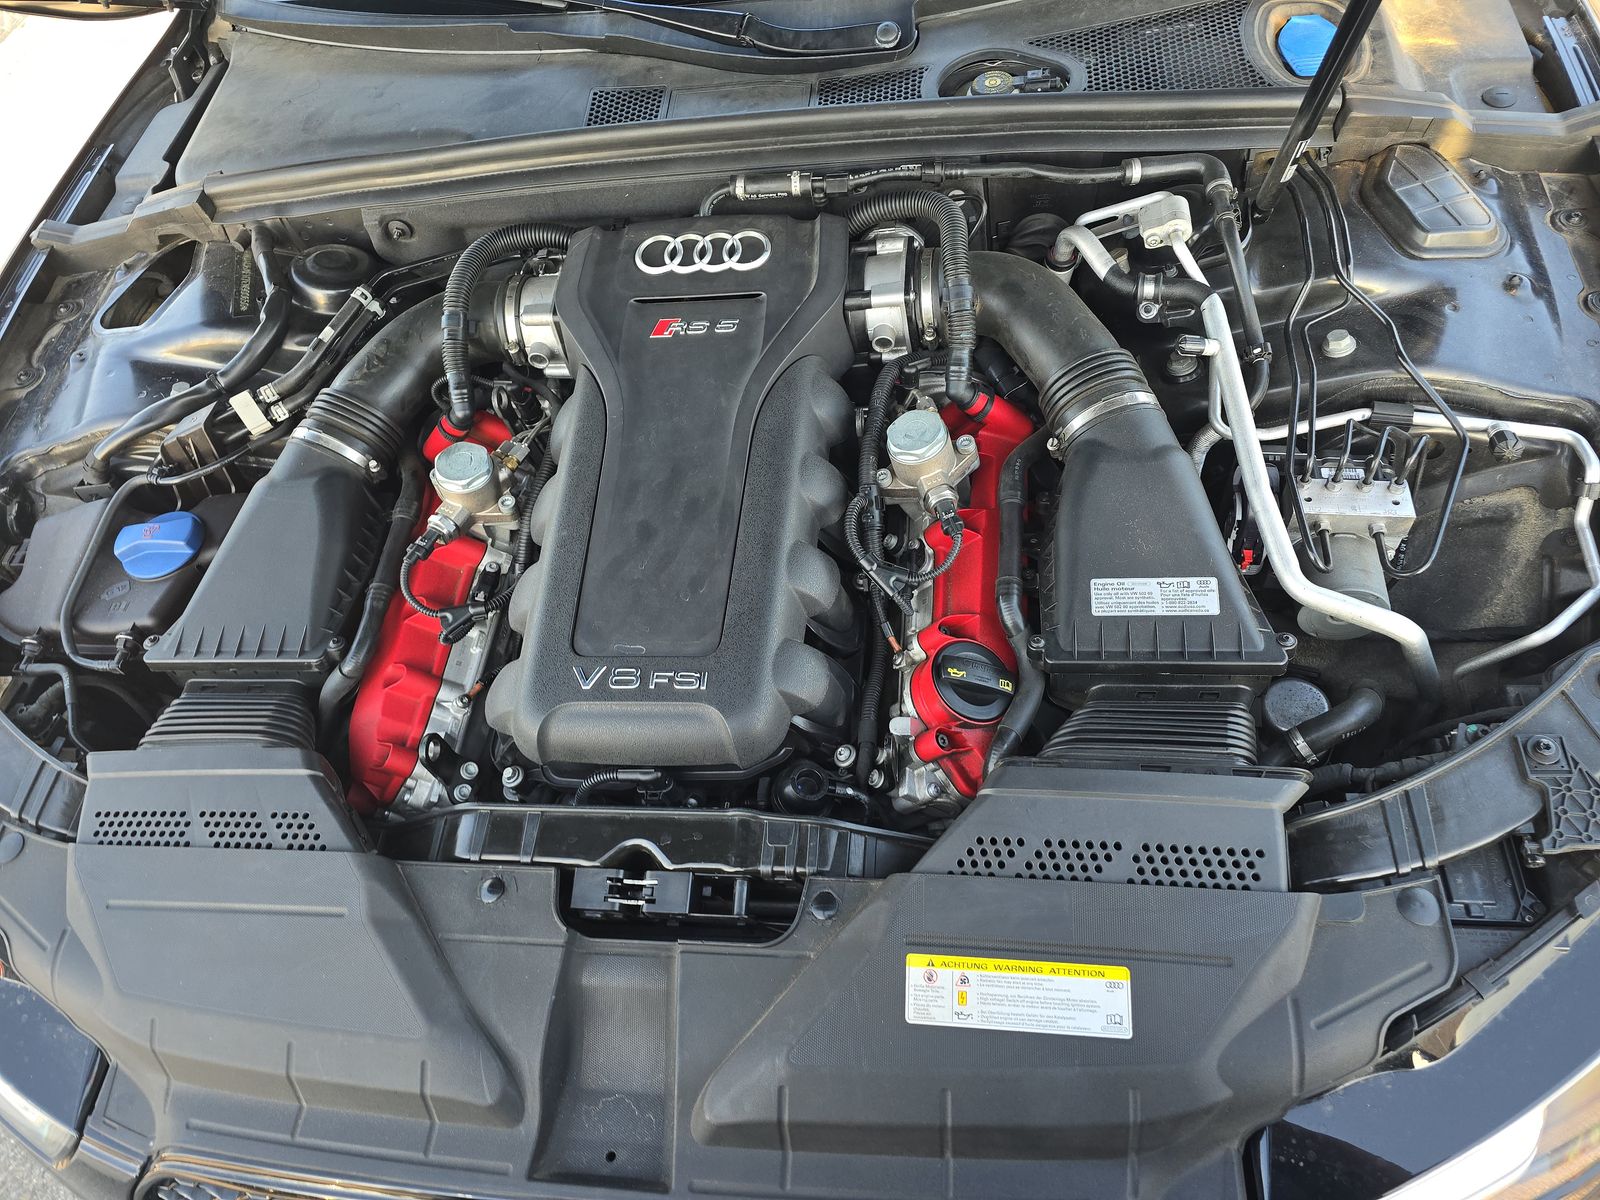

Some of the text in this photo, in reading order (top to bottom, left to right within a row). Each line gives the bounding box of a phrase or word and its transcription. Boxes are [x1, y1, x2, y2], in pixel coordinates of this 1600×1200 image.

[650, 318, 739, 338] RS 5
[573, 666, 708, 690] V8 FSI
[940, 961, 1105, 978] ACHTUNG WARNING ATTENTION
